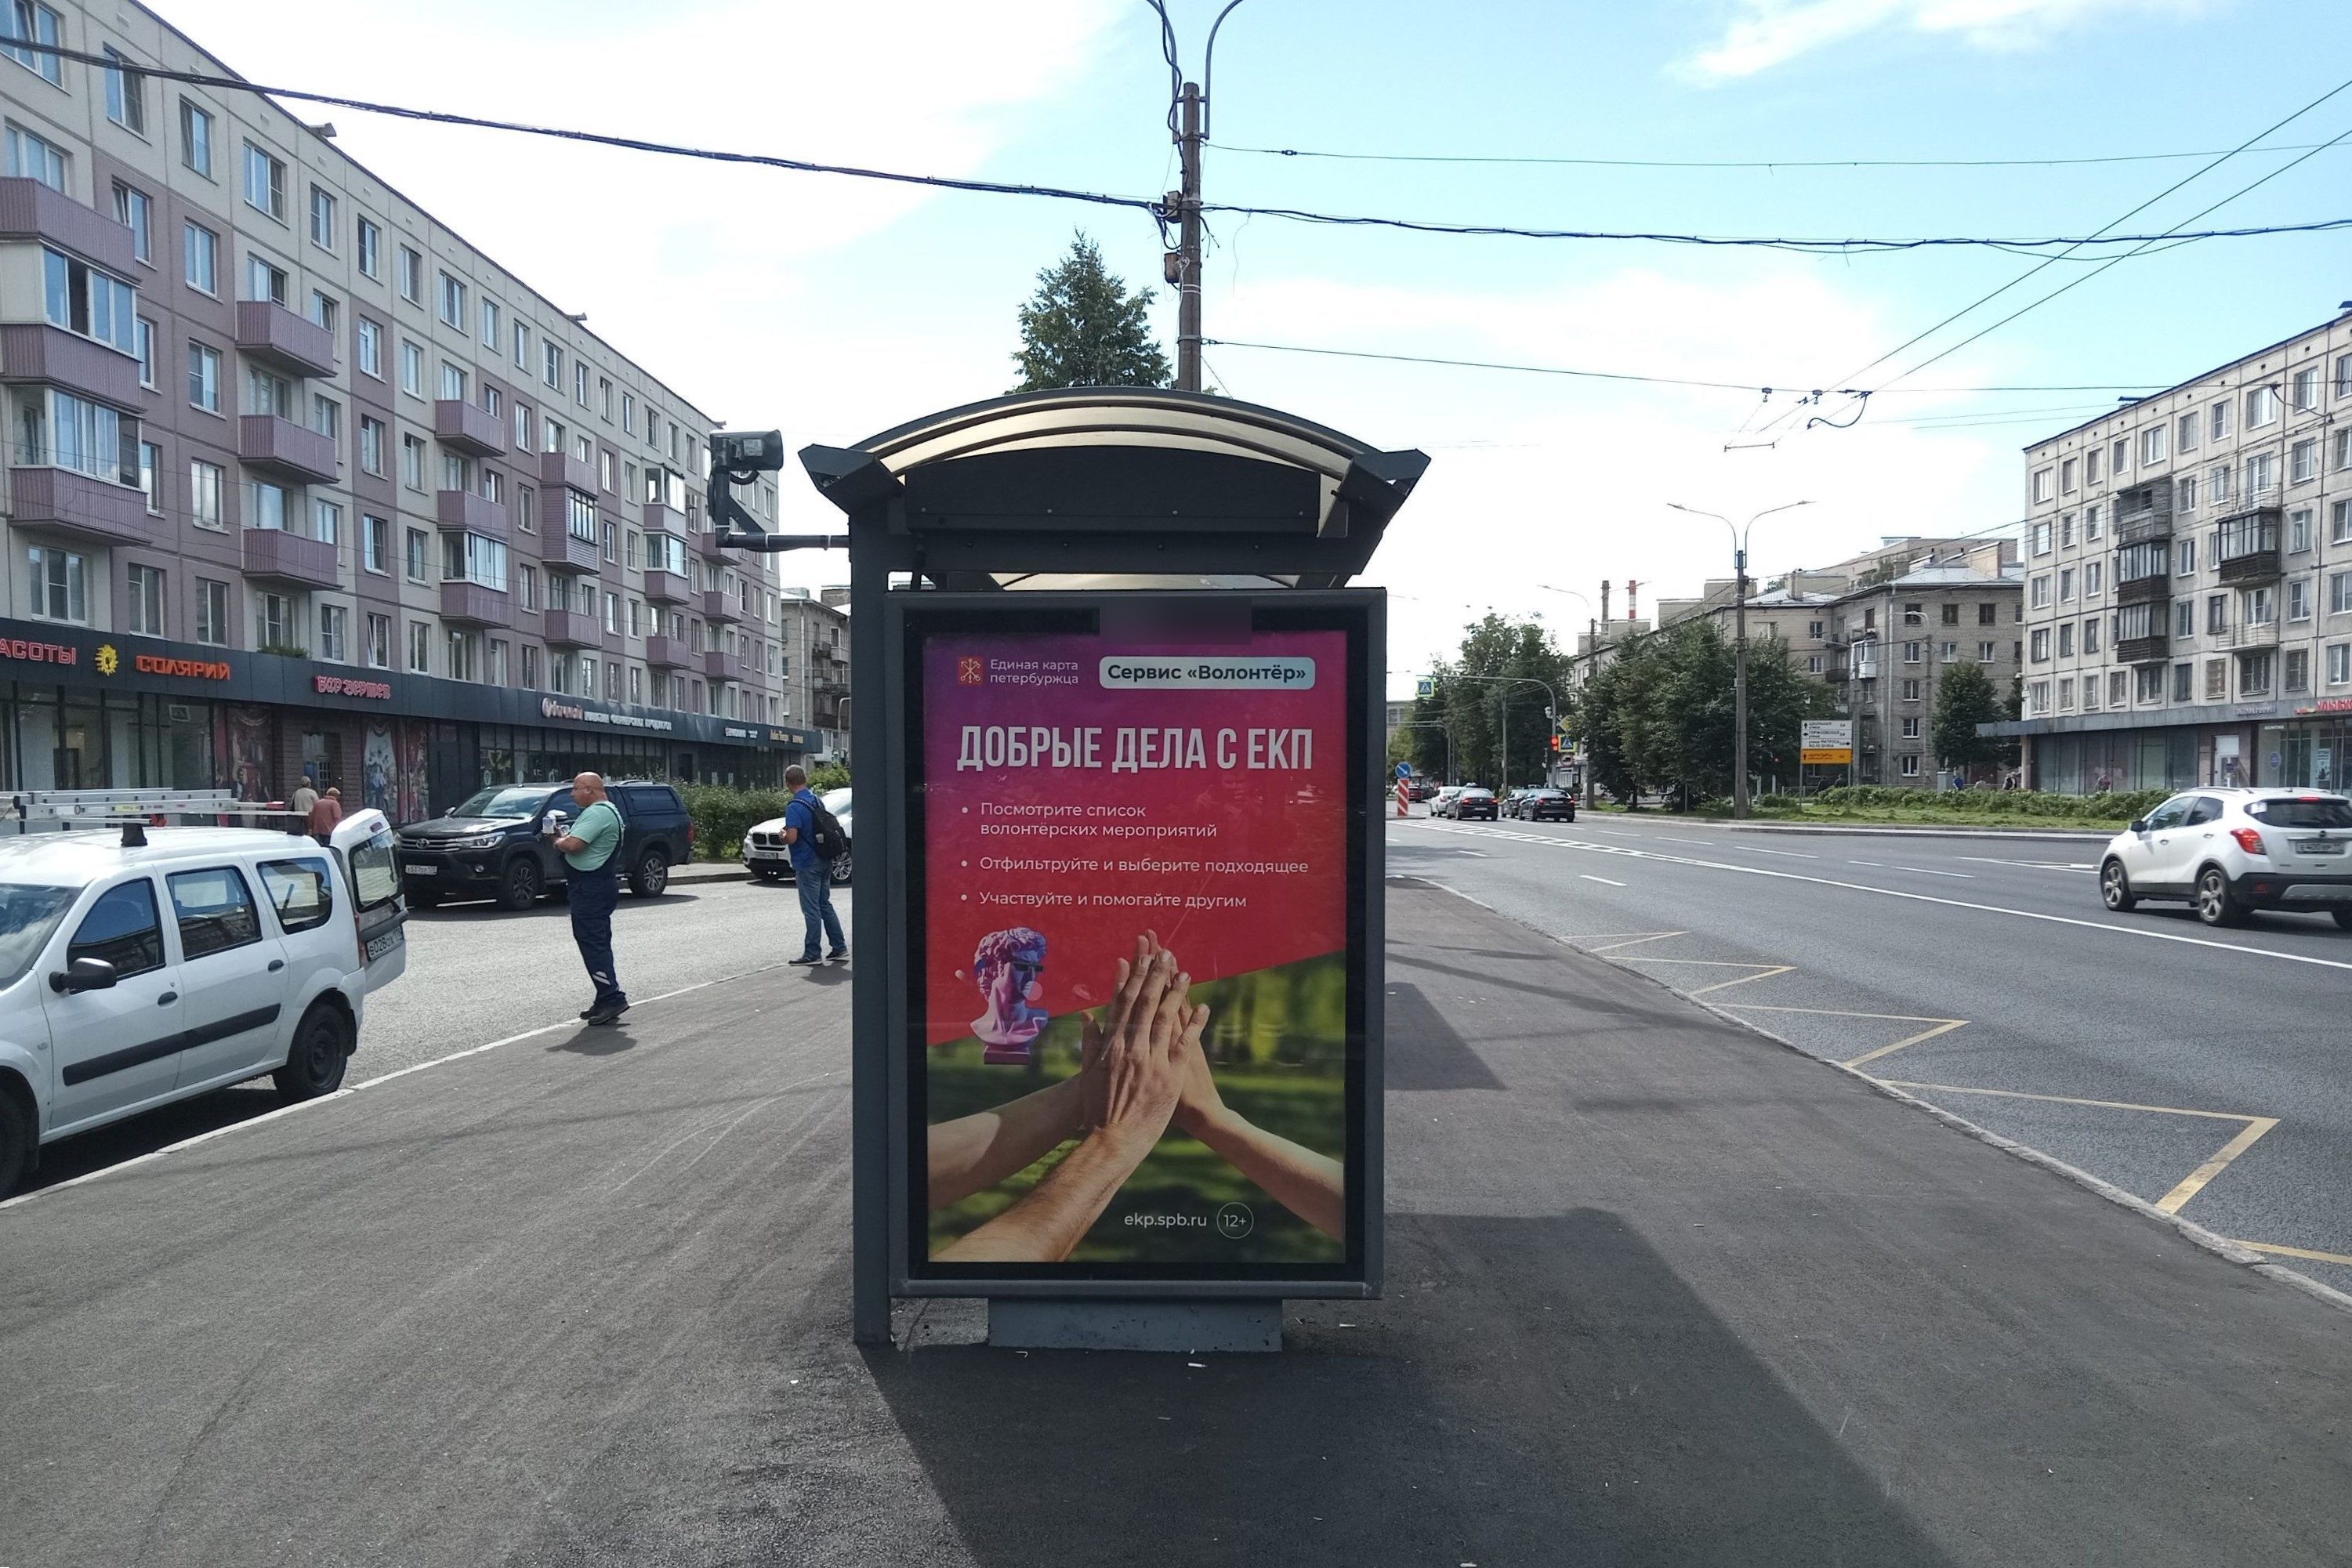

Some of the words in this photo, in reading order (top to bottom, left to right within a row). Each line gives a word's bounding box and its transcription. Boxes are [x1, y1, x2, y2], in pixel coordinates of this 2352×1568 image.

[136, 654, 231, 680] СОЛЯРИЙ
[990, 659, 1039, 672] Единая
[1042, 661, 1078, 672] карта
[1107, 664, 1182, 683] Сервис
[1187, 664, 1306, 683] «Волонтёр»
[990, 672, 1079, 686] петербуржца
[957, 726, 1102, 772] ДОБРЫЕ
[1112, 727, 1207, 773] ДЕЛА
[1216, 727, 1237, 770] С
[1247, 728, 1313, 770] ЕКП
[980, 802, 1082, 818] Посмотрите
[1086, 806, 1146, 817] список
[980, 822, 1098, 837] волонтёрских
[1102, 824, 1217, 839] мероприятий
[980, 856, 1099, 874] Отфильтруйте
[1104, 860, 1114, 871] и
[1118, 858, 1200, 875] выберите
[1205, 861, 1309, 875] подходящее
[980, 892, 1073, 907] Участвуйте
[1077, 895, 1088, 906] и
[1093, 893, 1181, 907] помогайте
[1185, 896, 1246, 910] другим
[1124, 1212, 1207, 1229] ekp.spb.ru
[1224, 1215, 1247, 1228] 12+
